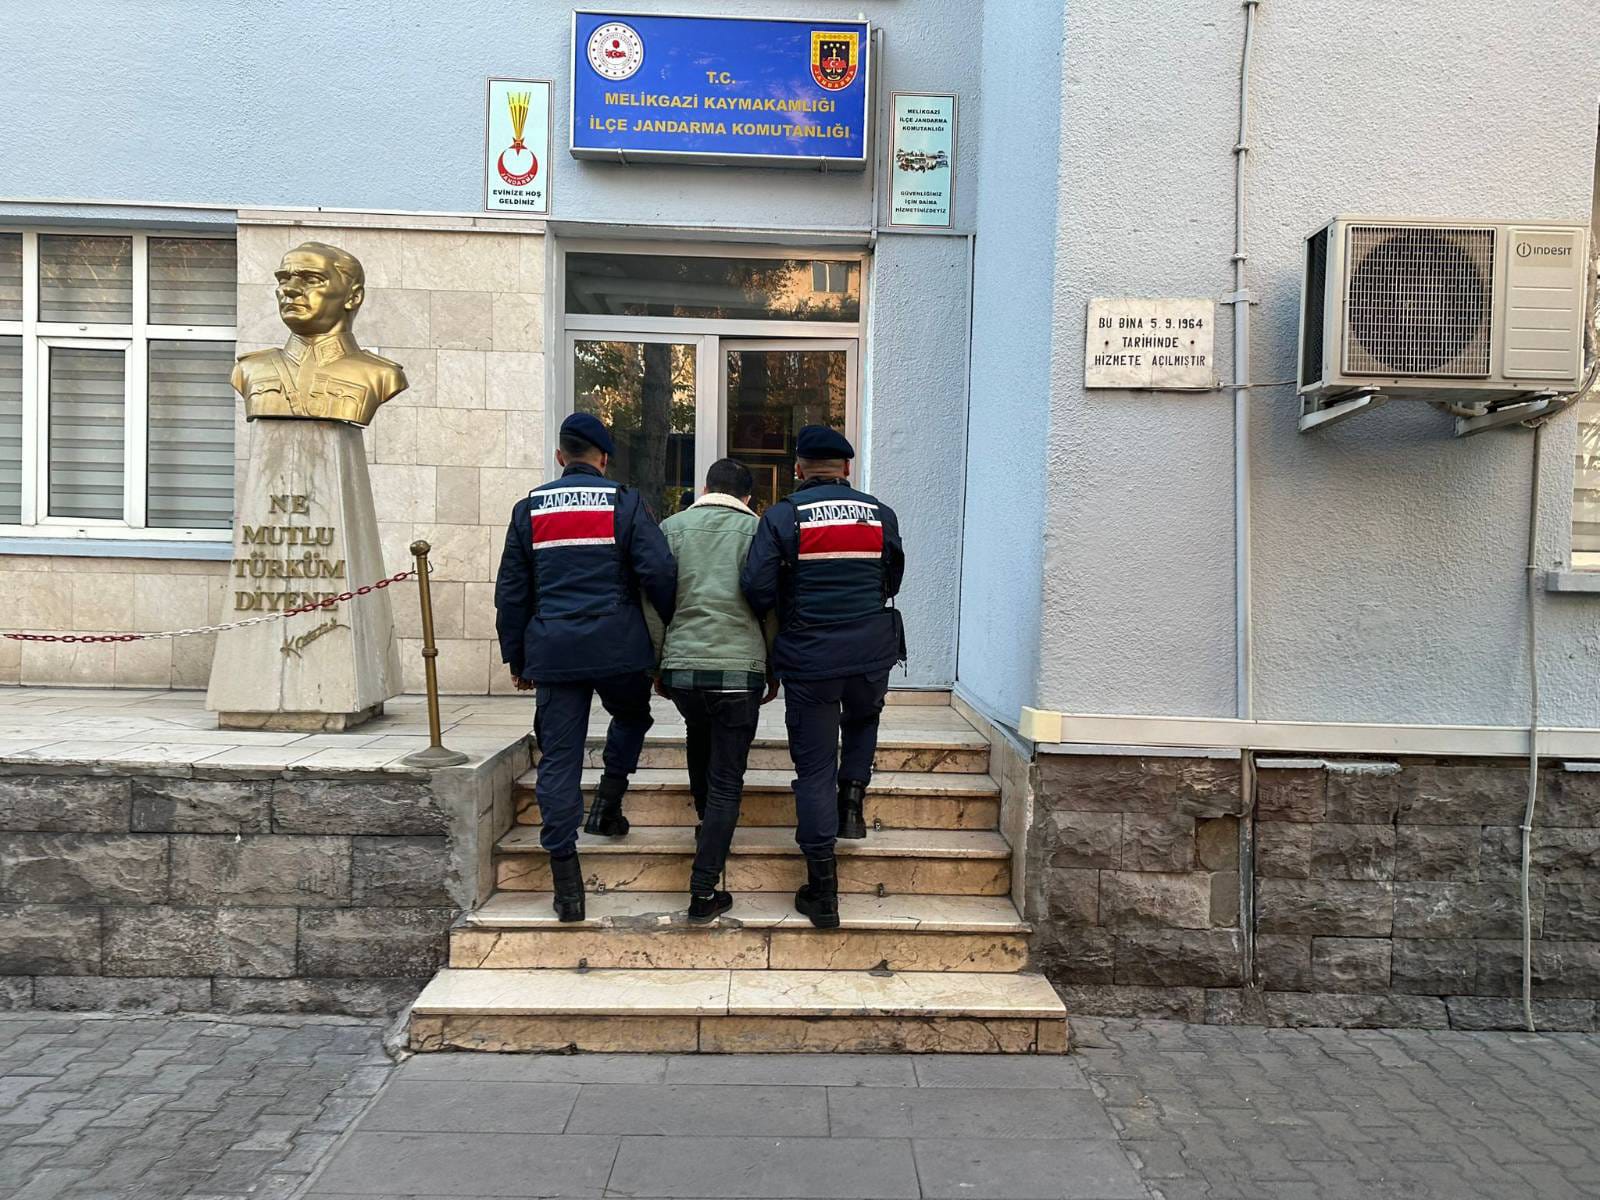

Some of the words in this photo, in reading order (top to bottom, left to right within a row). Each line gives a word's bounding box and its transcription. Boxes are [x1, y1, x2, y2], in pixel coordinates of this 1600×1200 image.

[706, 72, 736, 84] T.C.
[604, 92, 698, 108] MELİKGAZİ
[704, 97, 835, 112] KAYMAKAMLIĞI
[589, 114, 627, 133] İLÇE
[633, 119, 727, 135] JANDARMA
[732, 123, 850, 138] KOMUTANLIĞI
[1098, 317, 1112, 329] BU
[1119, 315, 1143, 329] BİNA
[1122, 333, 1179, 348] TARİHİNDE
[1094, 352, 1142, 366] HİZMETE
[1152, 354, 1206, 369] AÇILMIŞTIR
[268, 494, 310, 515] NE
[539, 492, 608, 508] JANDARMA
[808, 504, 875, 521] JANDARMA
[241, 525, 335, 546] MUTLU
[233, 551, 346, 579] TÜRKÜM
[234, 585, 339, 611] DİYENE
